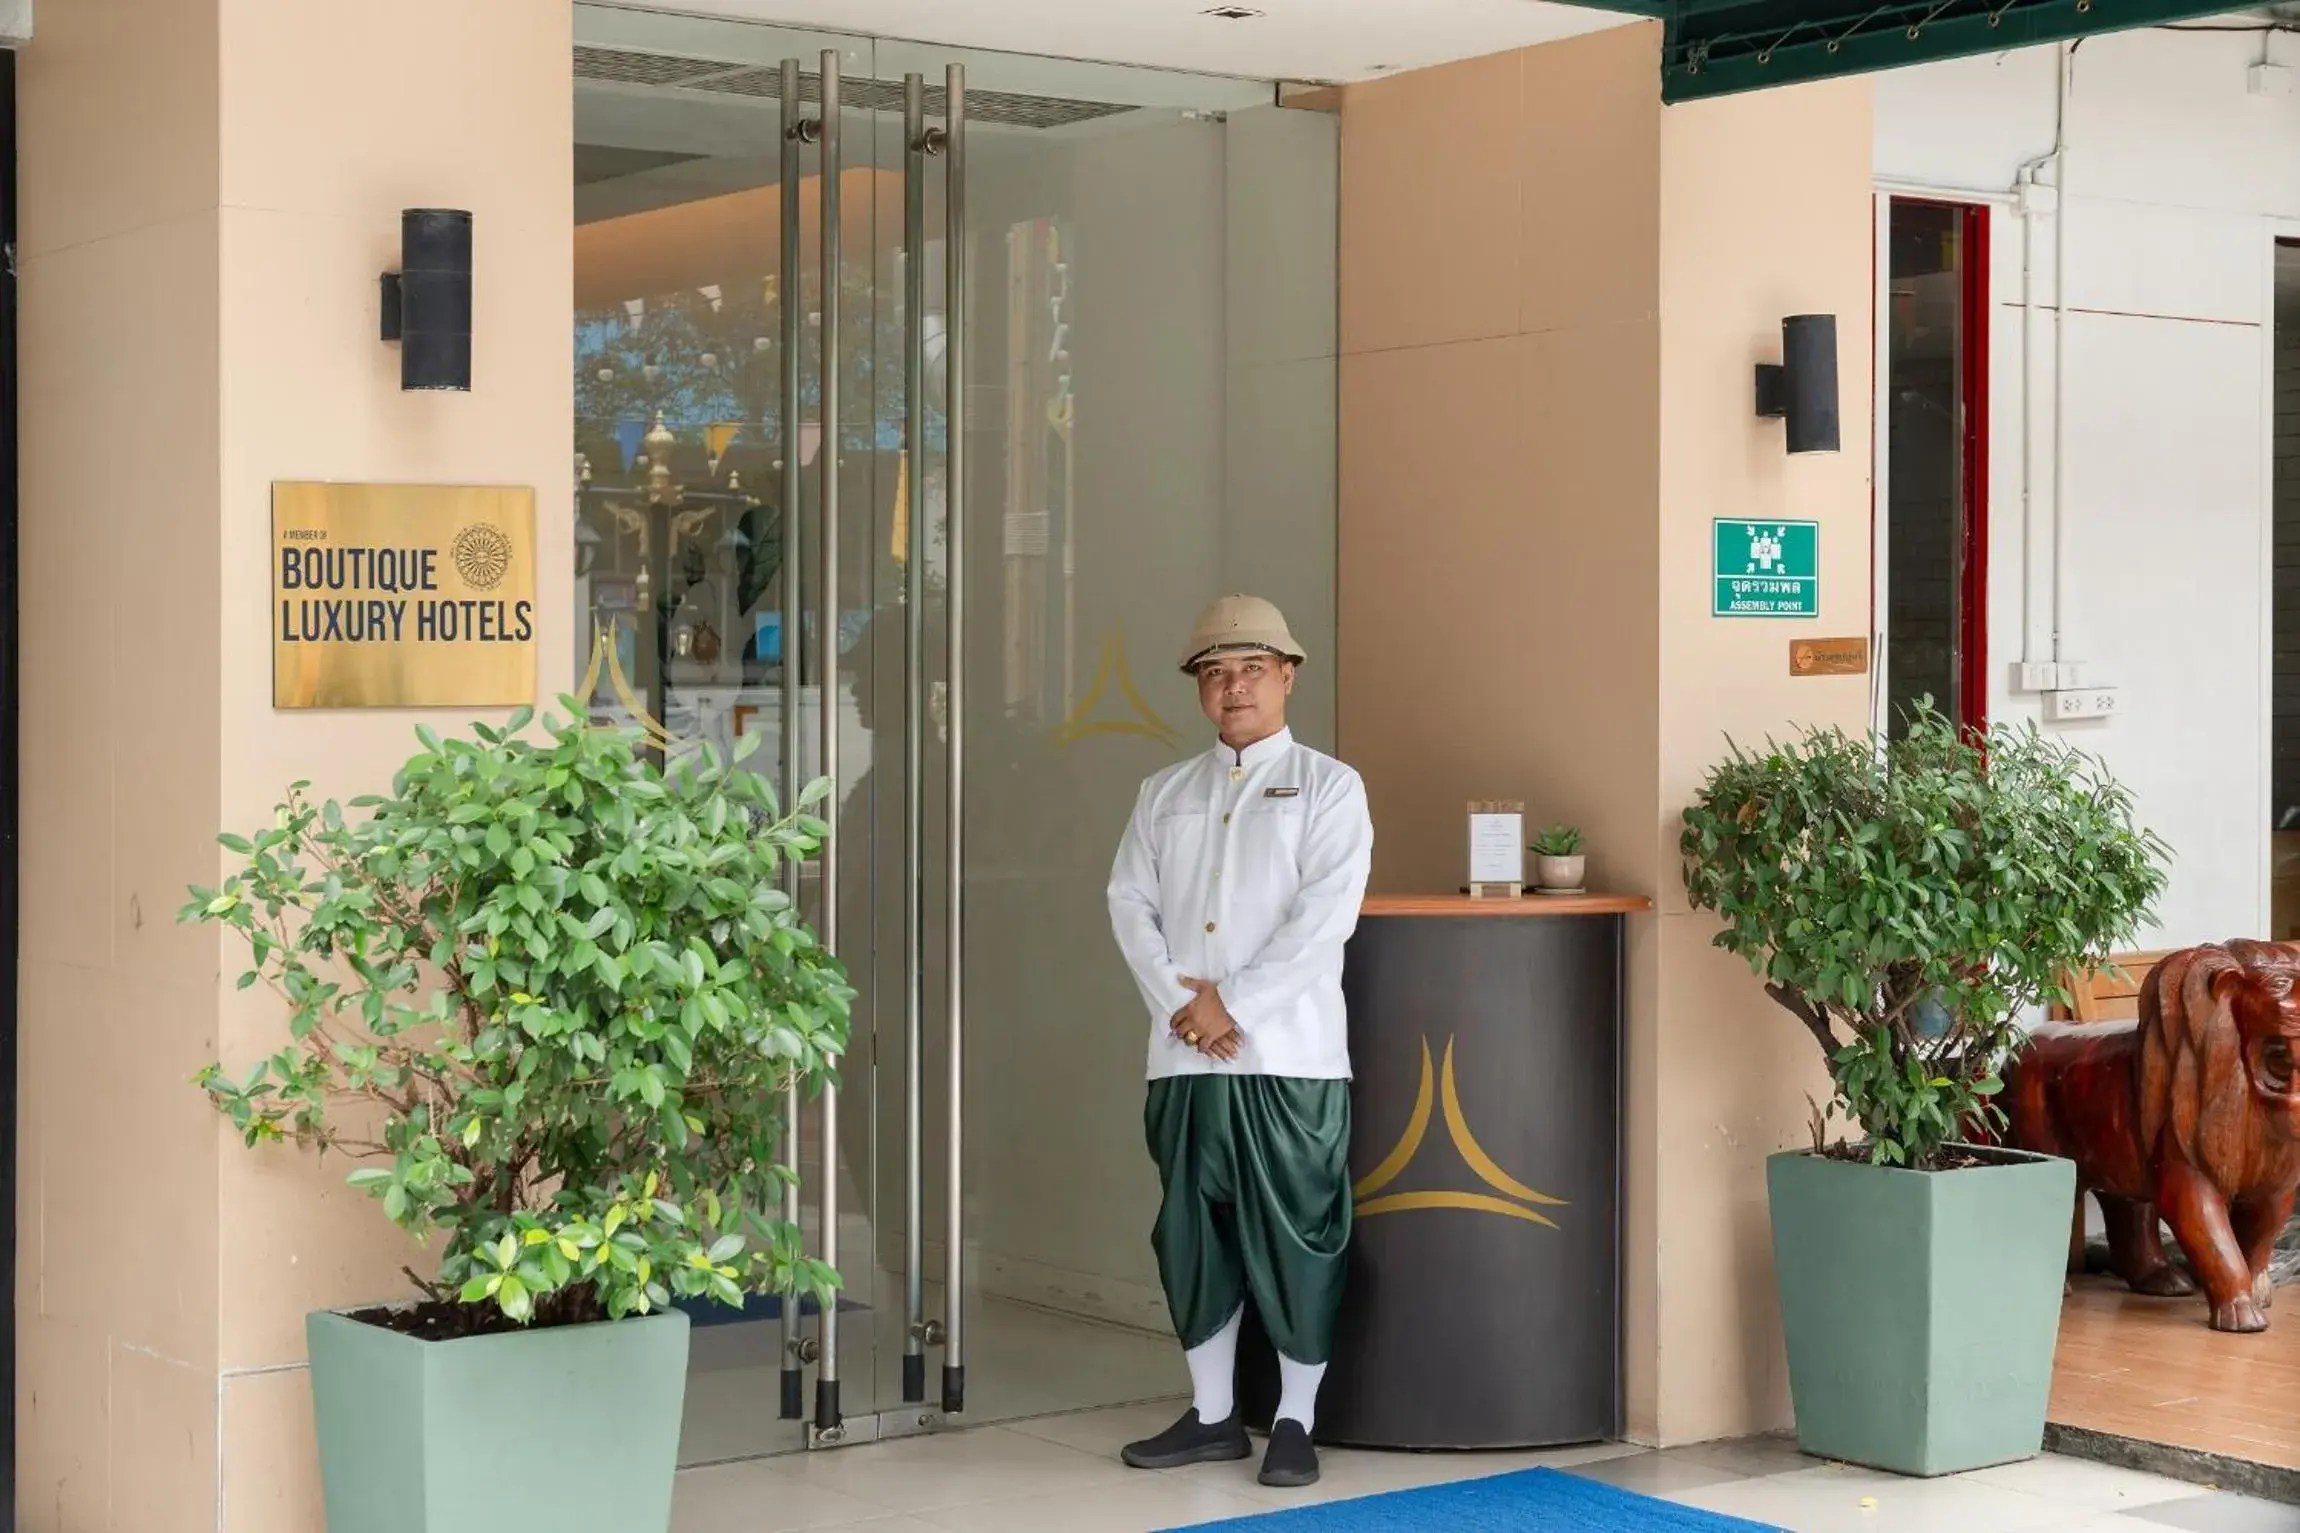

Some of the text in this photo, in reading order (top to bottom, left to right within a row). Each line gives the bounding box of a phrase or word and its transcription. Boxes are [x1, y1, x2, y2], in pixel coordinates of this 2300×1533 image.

[289, 530, 318, 540] MEMBER
[282, 547, 437, 594] BOUTIQUE
[1731, 579, 1801, 599] จุดรวมพล
[1729, 600, 1802, 611] ASSEMBLY POINT
[282, 600, 532, 641] LUXURY HOTELS
